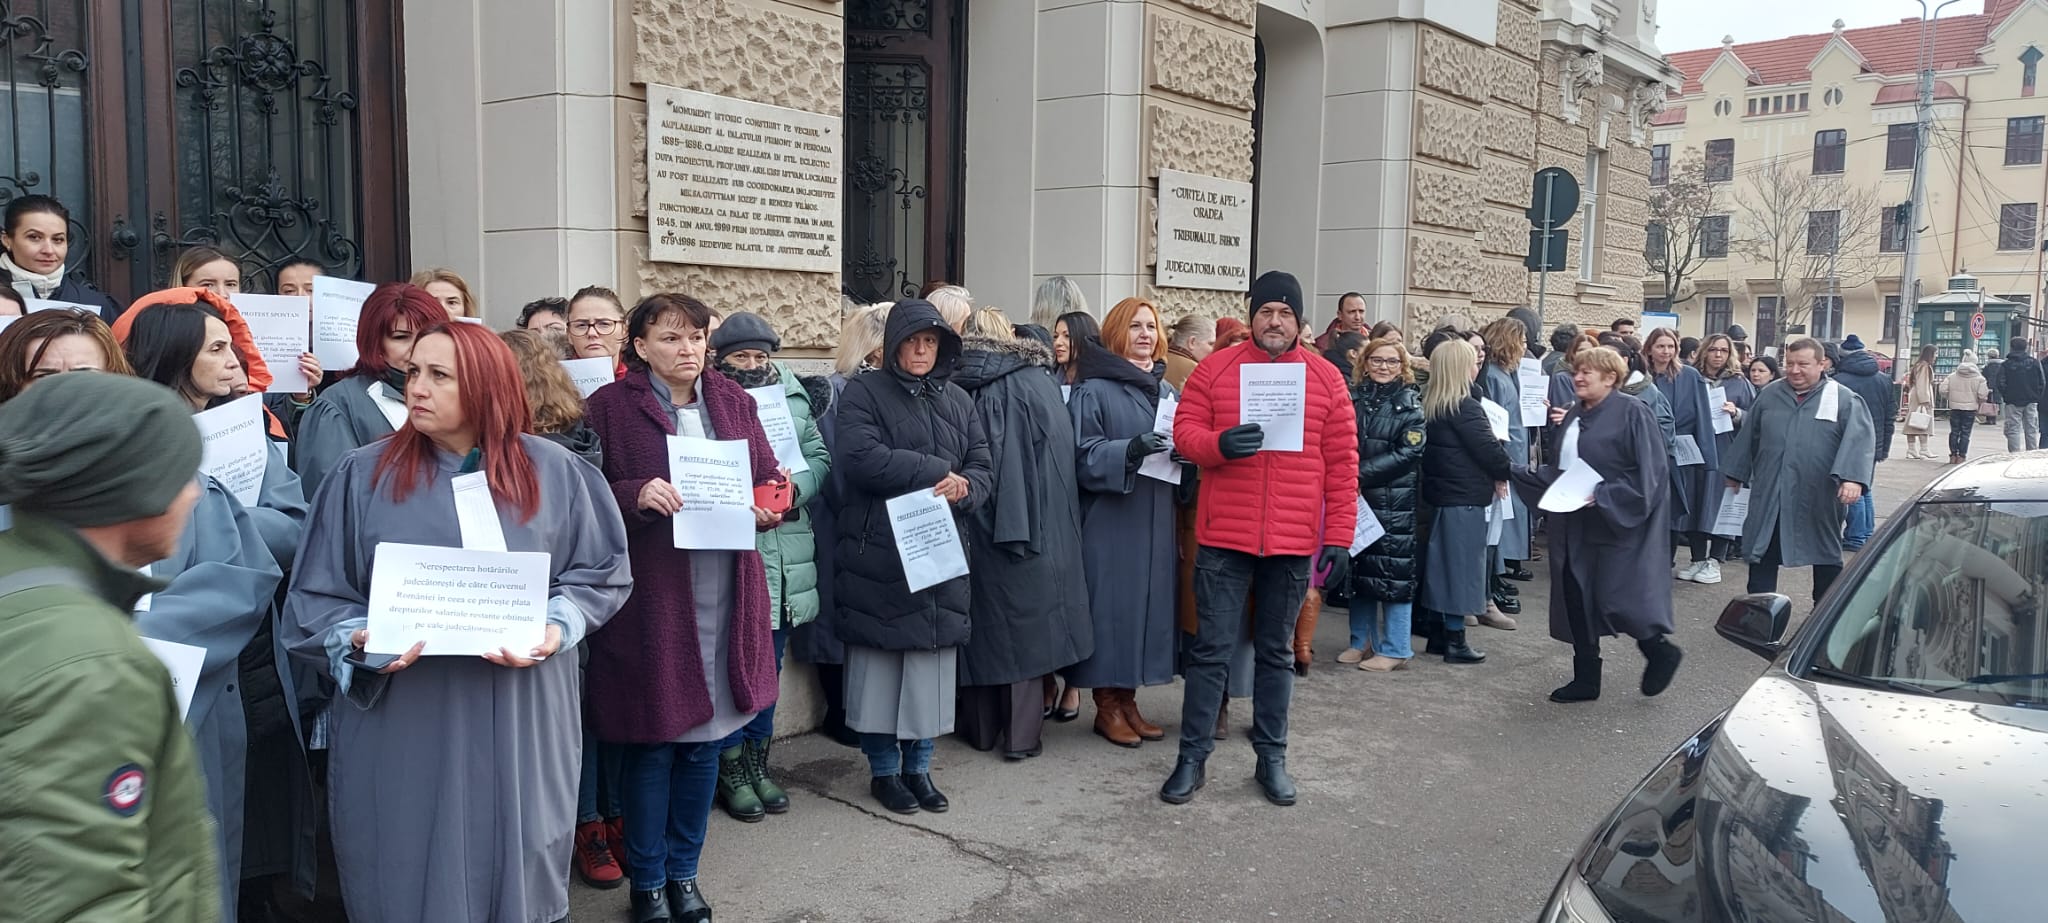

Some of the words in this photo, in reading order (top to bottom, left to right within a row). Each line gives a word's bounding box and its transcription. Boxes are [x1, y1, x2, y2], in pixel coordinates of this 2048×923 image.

[673, 105, 712, 119] MONUMENT
[657, 169, 667, 178] AU
[669, 171, 689, 181] FOST
[1176, 187, 1205, 203] CURTEA
[1207, 192, 1218, 205] DE
[1219, 194, 1238, 207] APEL
[717, 209, 727, 217] CA
[752, 212, 761, 221] DE
[1193, 207, 1223, 221] ORADEA
[680, 220, 692, 229] DIN
[1173, 228, 1217, 245] TRIBUNALUL
[1219, 234, 1240, 247] BIHOR
[766, 244, 775, 253] DE
[1165, 260, 1215, 275] JUDECATORIA
[1217, 265, 1245, 278] ORADEA
[457, 580, 467, 588] de
[490, 581, 527, 591] Guvernul
